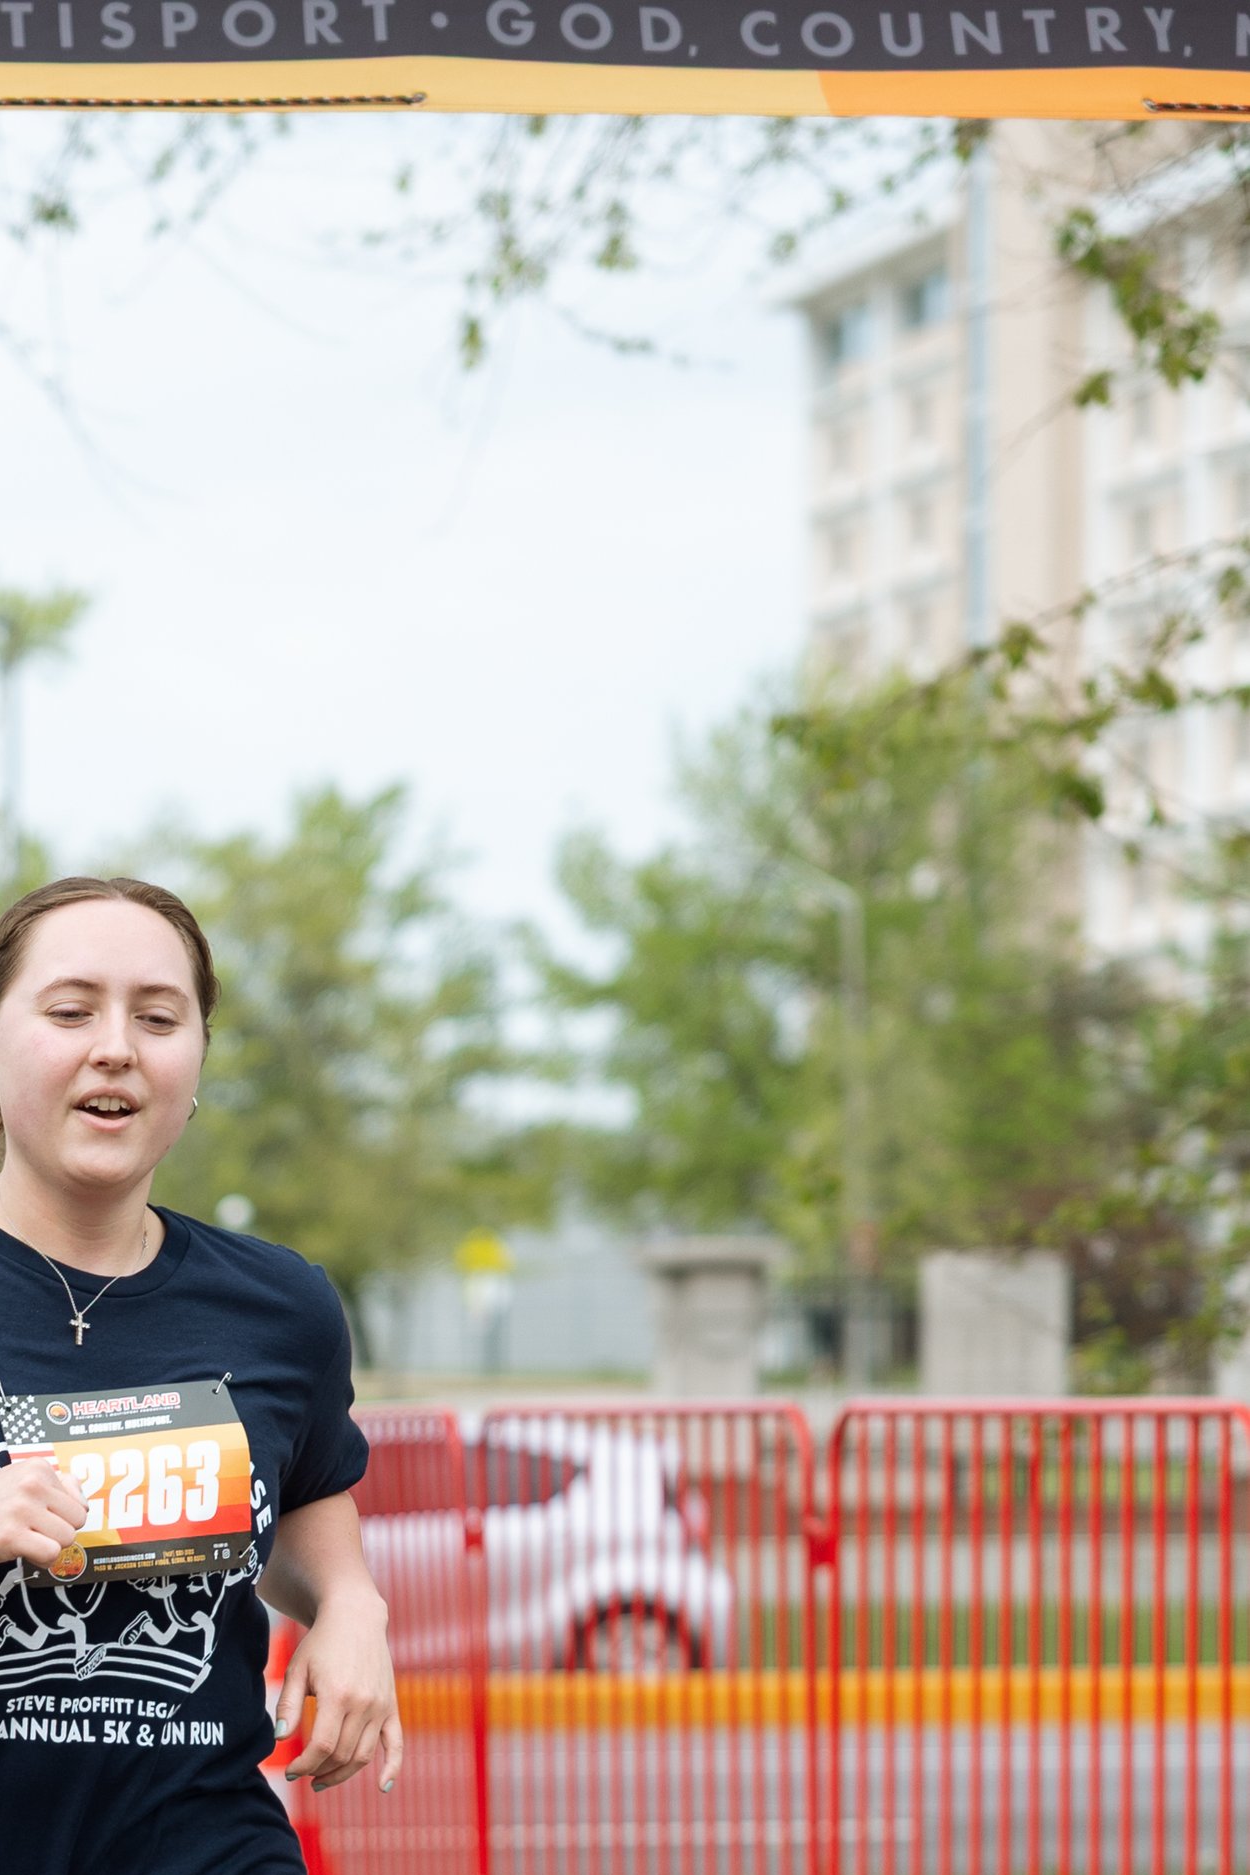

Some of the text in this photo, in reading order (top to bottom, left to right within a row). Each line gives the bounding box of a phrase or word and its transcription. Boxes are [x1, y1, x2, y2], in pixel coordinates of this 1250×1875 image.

[486, 0, 698, 57] GOD,
[740, 6, 1193, 58] COUNTRY,
[72, 1392, 181, 1416] HEARTLAND
[70, 1440, 220, 1532] 2263
[6, 1695, 55, 1713] STEVE
[60, 1697, 134, 1715] PROFFITT
[103, 1720, 131, 1745] 5K
[136, 1724, 155, 1747] &
[160, 1721, 185, 1745] UN
[190, 1721, 224, 1746] RUN
